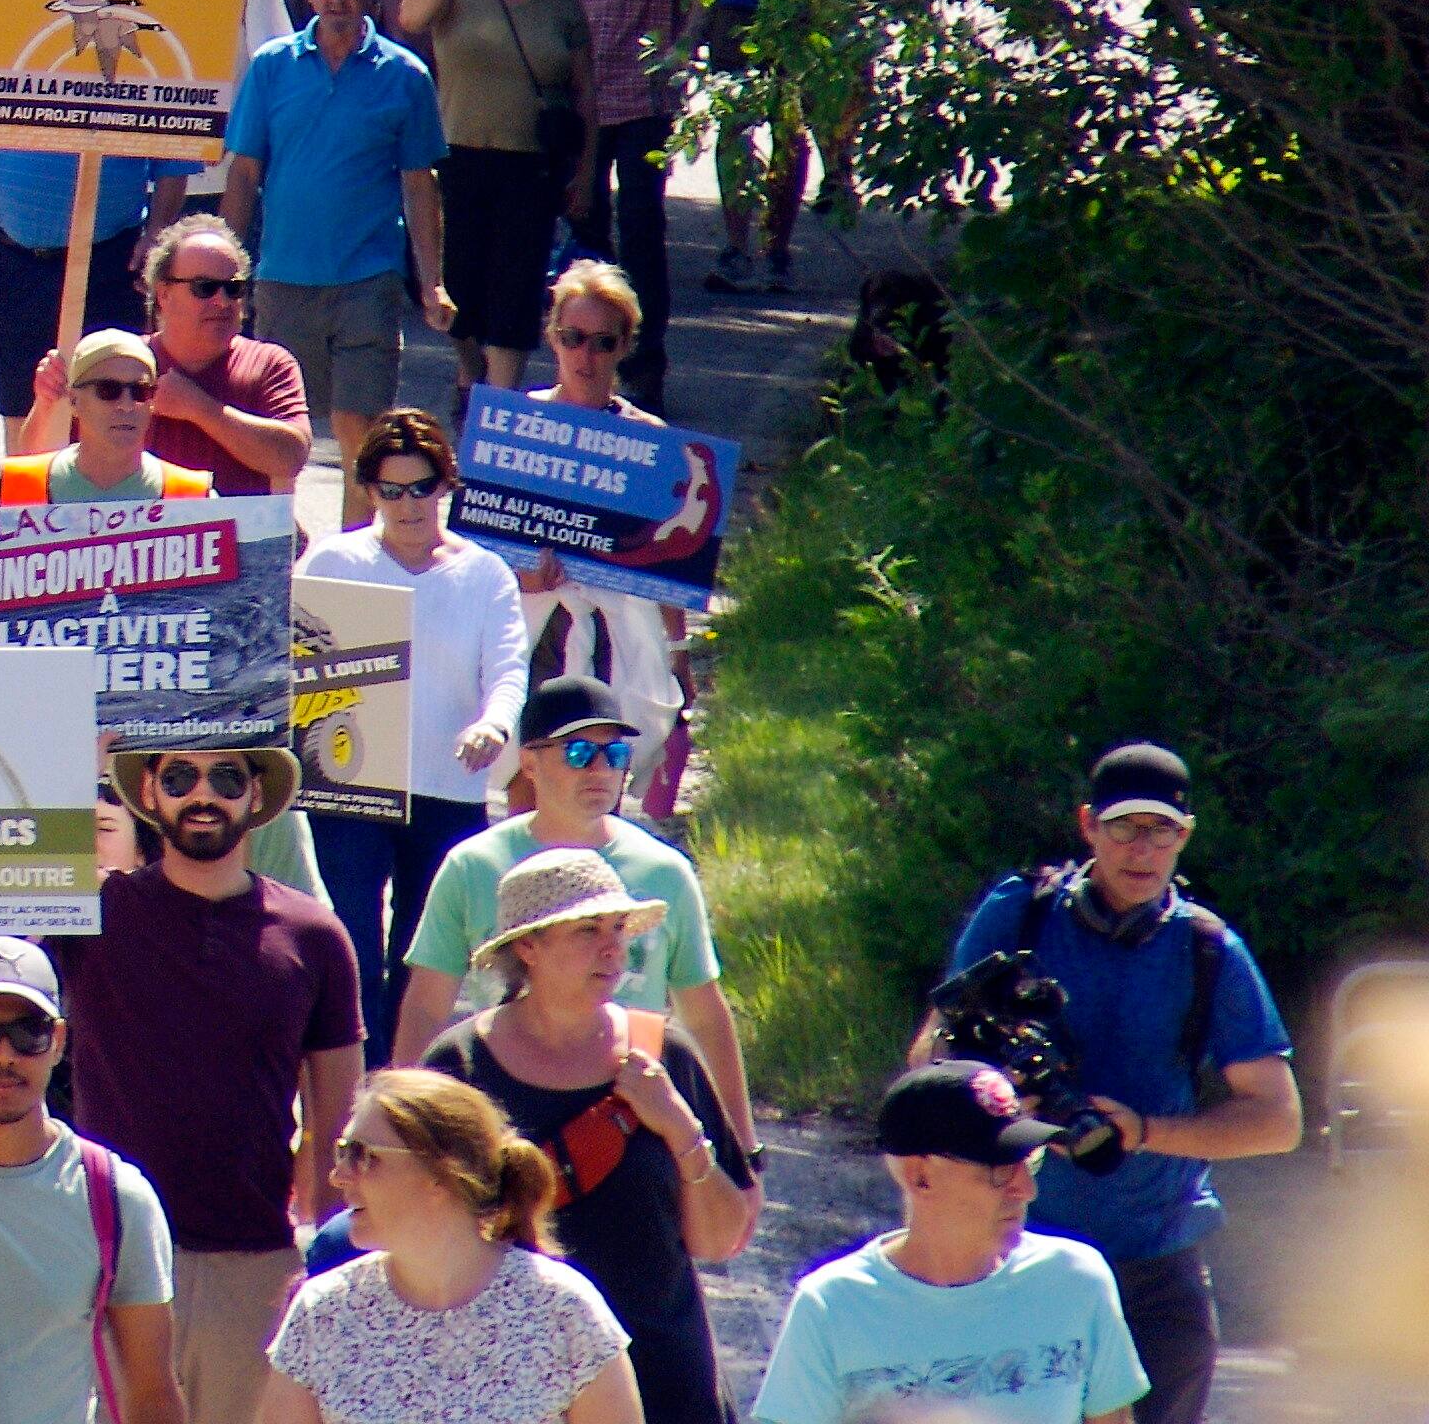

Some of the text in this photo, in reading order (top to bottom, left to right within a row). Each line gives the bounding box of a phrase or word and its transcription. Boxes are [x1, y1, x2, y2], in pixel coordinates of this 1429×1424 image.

[22, 74, 32, 93] À
[37, 78, 57, 95] LA
[63, 79, 148, 100] POUSSIÈRE
[153, 85, 220, 105] TOXIQUE
[13, 106, 33, 120] AU
[35, 108, 88, 124] PROJET
[90, 111, 137, 126] MINIER
[140, 115, 157, 127] LA
[159, 116, 213, 131] LOUTRE
[481, 406, 660, 467] LE ZÉRO RISQUE
[474, 440, 628, 494] N'EXISTE PAS
[460, 505, 614, 553] MINIER LA LOUTRE
[463, 488, 598, 531] NON AU PROJET
[99, 587, 120, 614] À
